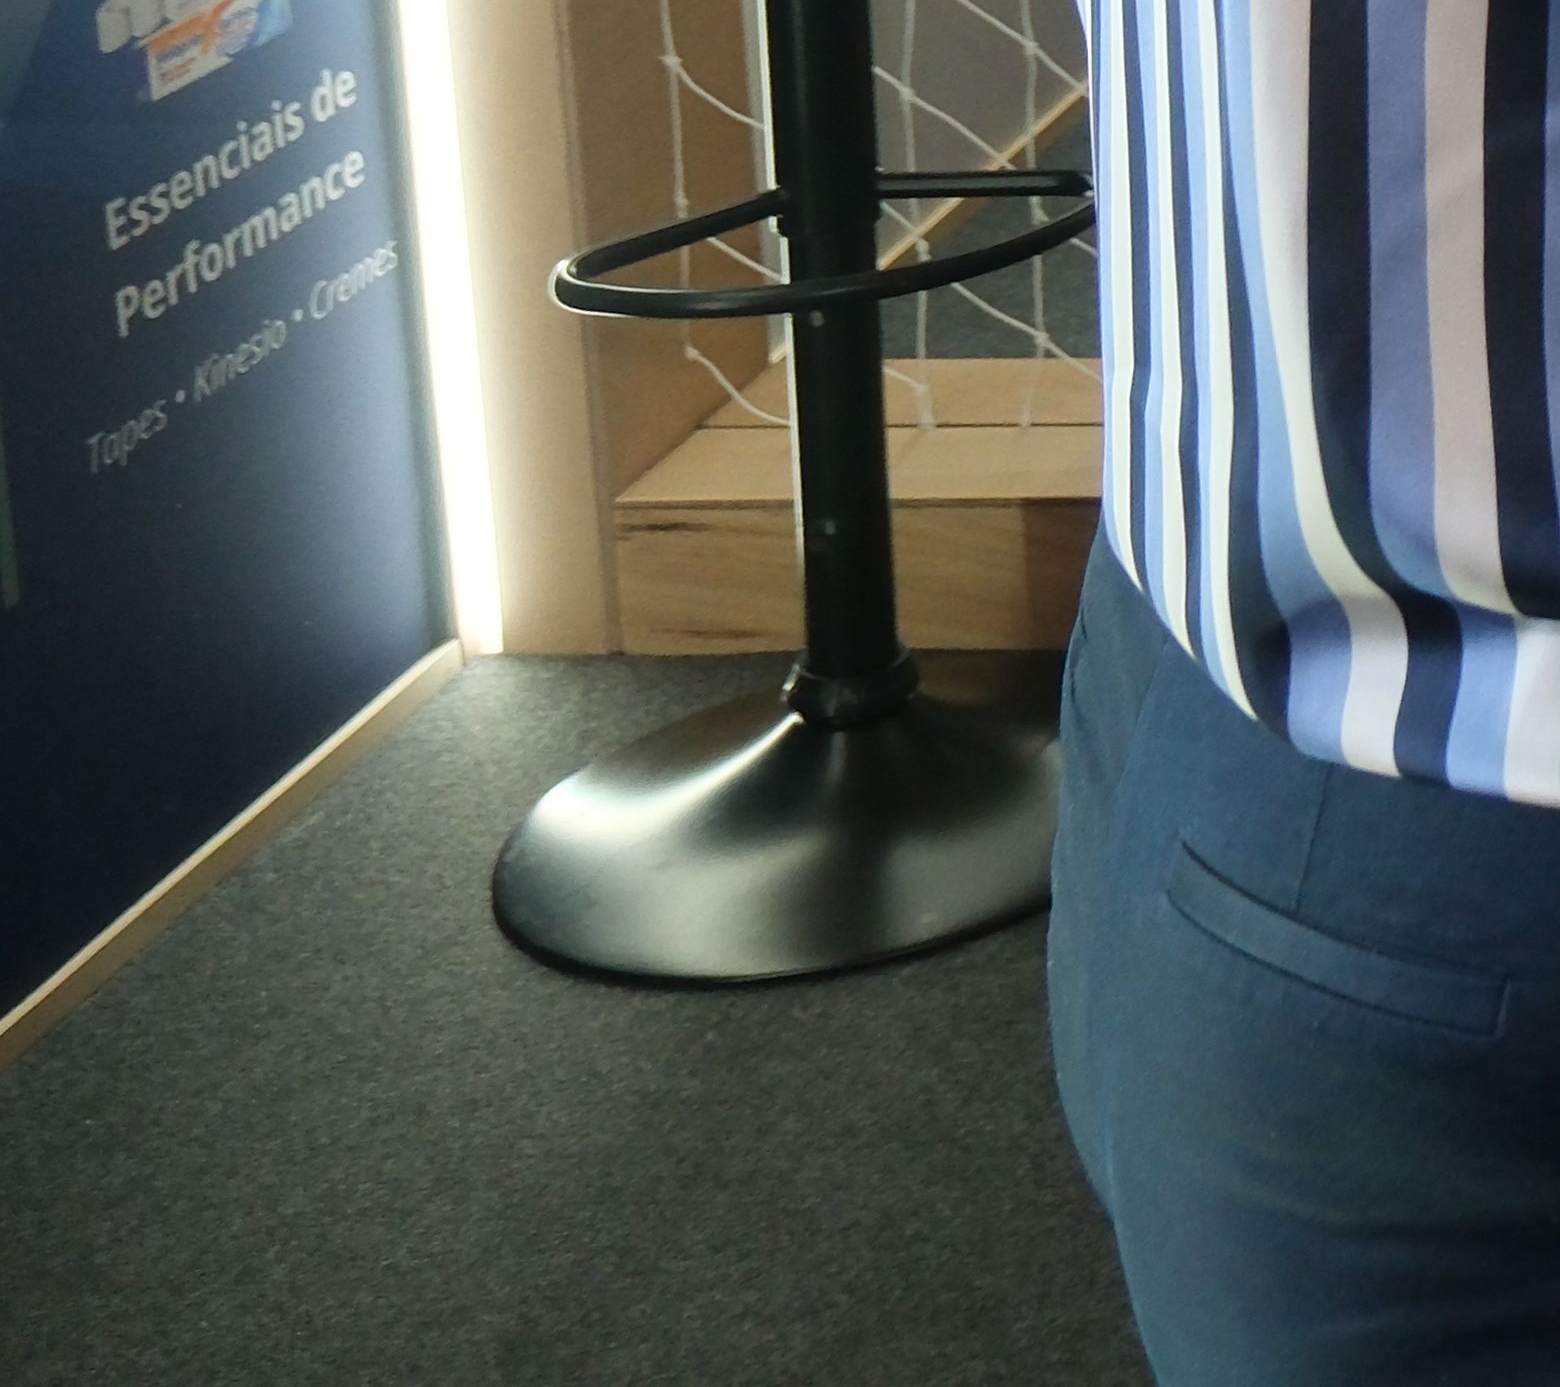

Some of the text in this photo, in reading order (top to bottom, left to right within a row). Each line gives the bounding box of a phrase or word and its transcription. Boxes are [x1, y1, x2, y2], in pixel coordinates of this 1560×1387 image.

[105, 68, 358, 252] Essenciais de
[115, 150, 366, 337] Performance
[85, 239, 400, 475] Tapes Kinesio Cremes
